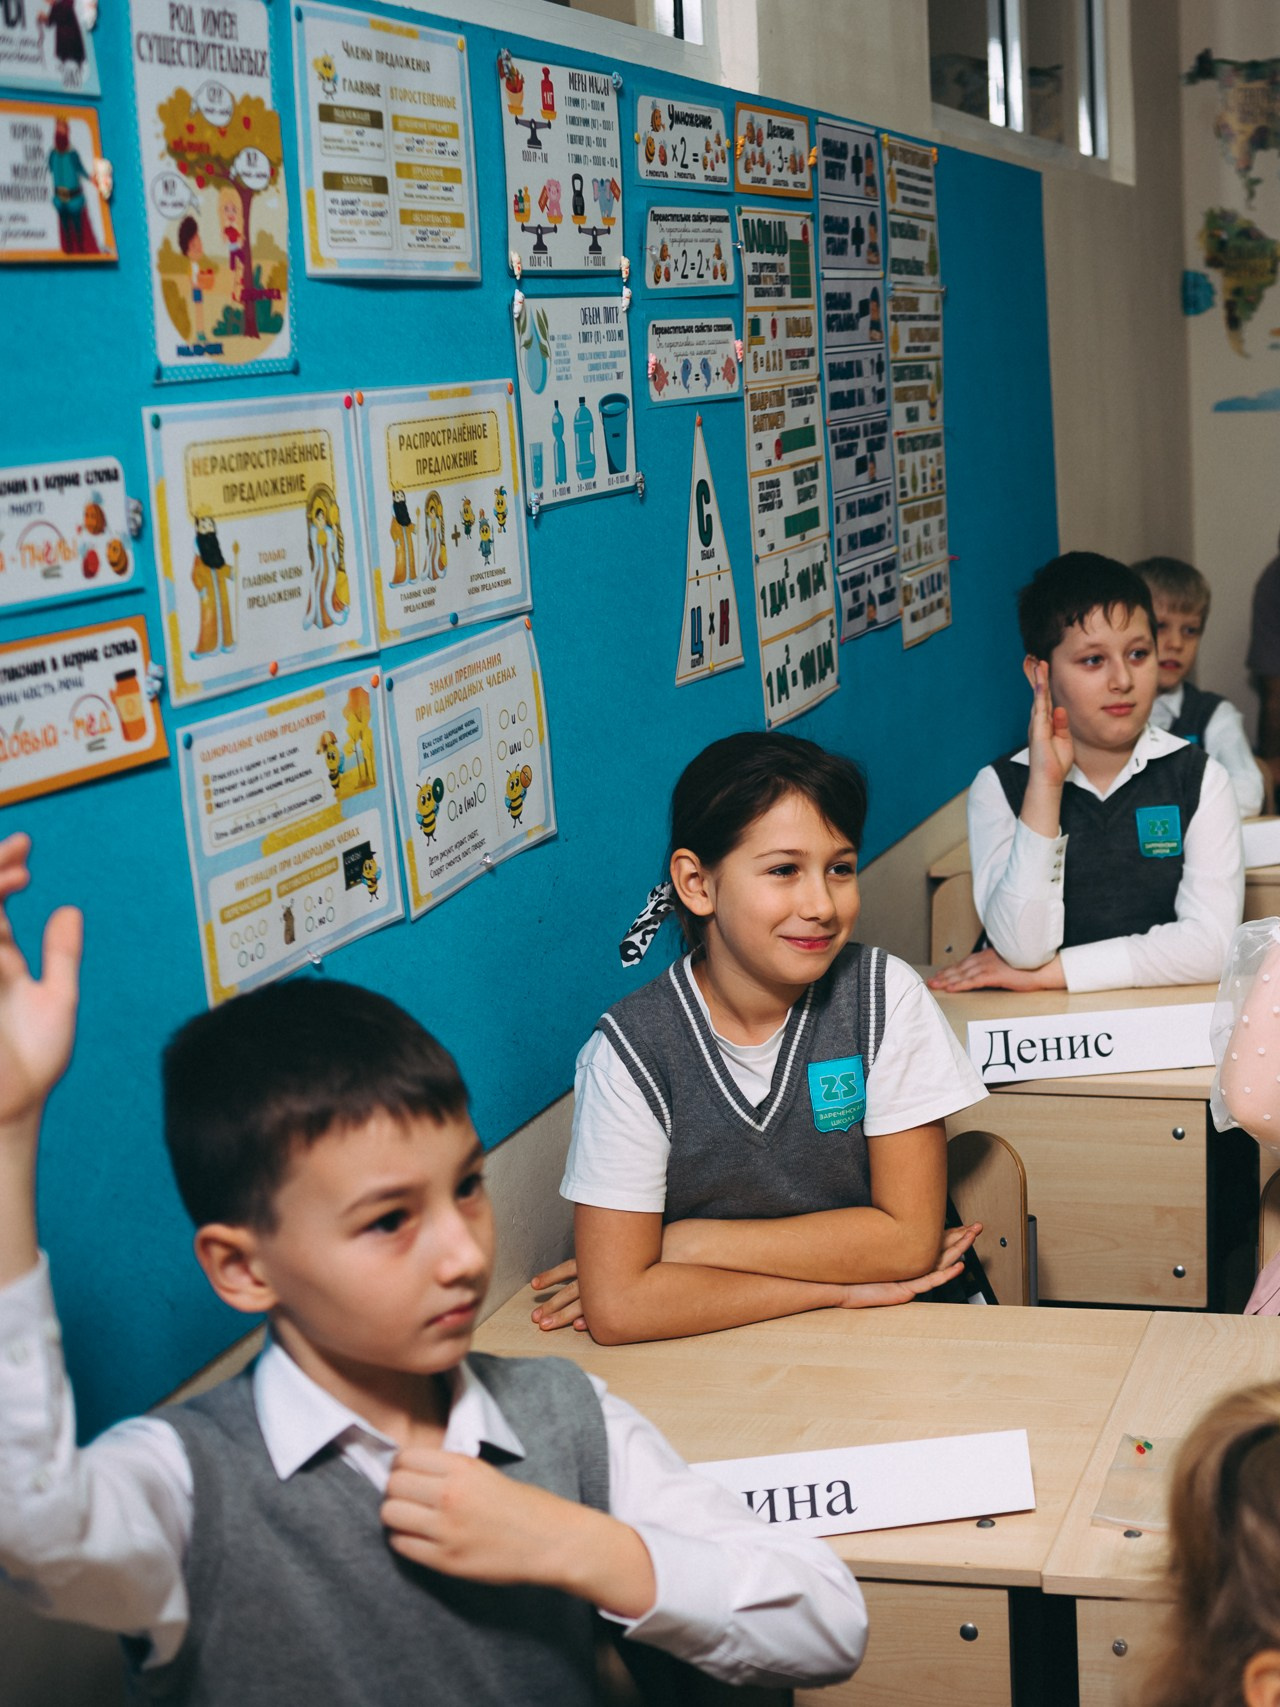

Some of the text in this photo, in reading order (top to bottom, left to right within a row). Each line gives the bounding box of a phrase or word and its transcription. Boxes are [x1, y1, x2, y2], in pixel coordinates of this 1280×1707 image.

[169, 2, 195, 35] РОД
[569, 72, 587, 93] МЕРЫ
[680, 136, 688, 169] 2
[681, 249, 689, 279] 2
[697, 249, 704, 279] 2
[398, 422, 488, 451] РАСПРОСТРАНЁННОЕ
[191, 442, 327, 478] НЕРАСПРОСТРАНЁННОЕ
[416, 450, 478, 476] ПРЕДЛОЖЕНИЕ
[223, 474, 307, 504] ПРЕДЛОЖЕНИЕ
[429, 653, 502, 696] ЗНАКИ ПРЕПИНАНИЯ
[415, 666, 517, 722] ПРИ ОДНОРОДНЫХ ЧЛЕНАХ
[982, 1029, 1114, 1077] Денис
